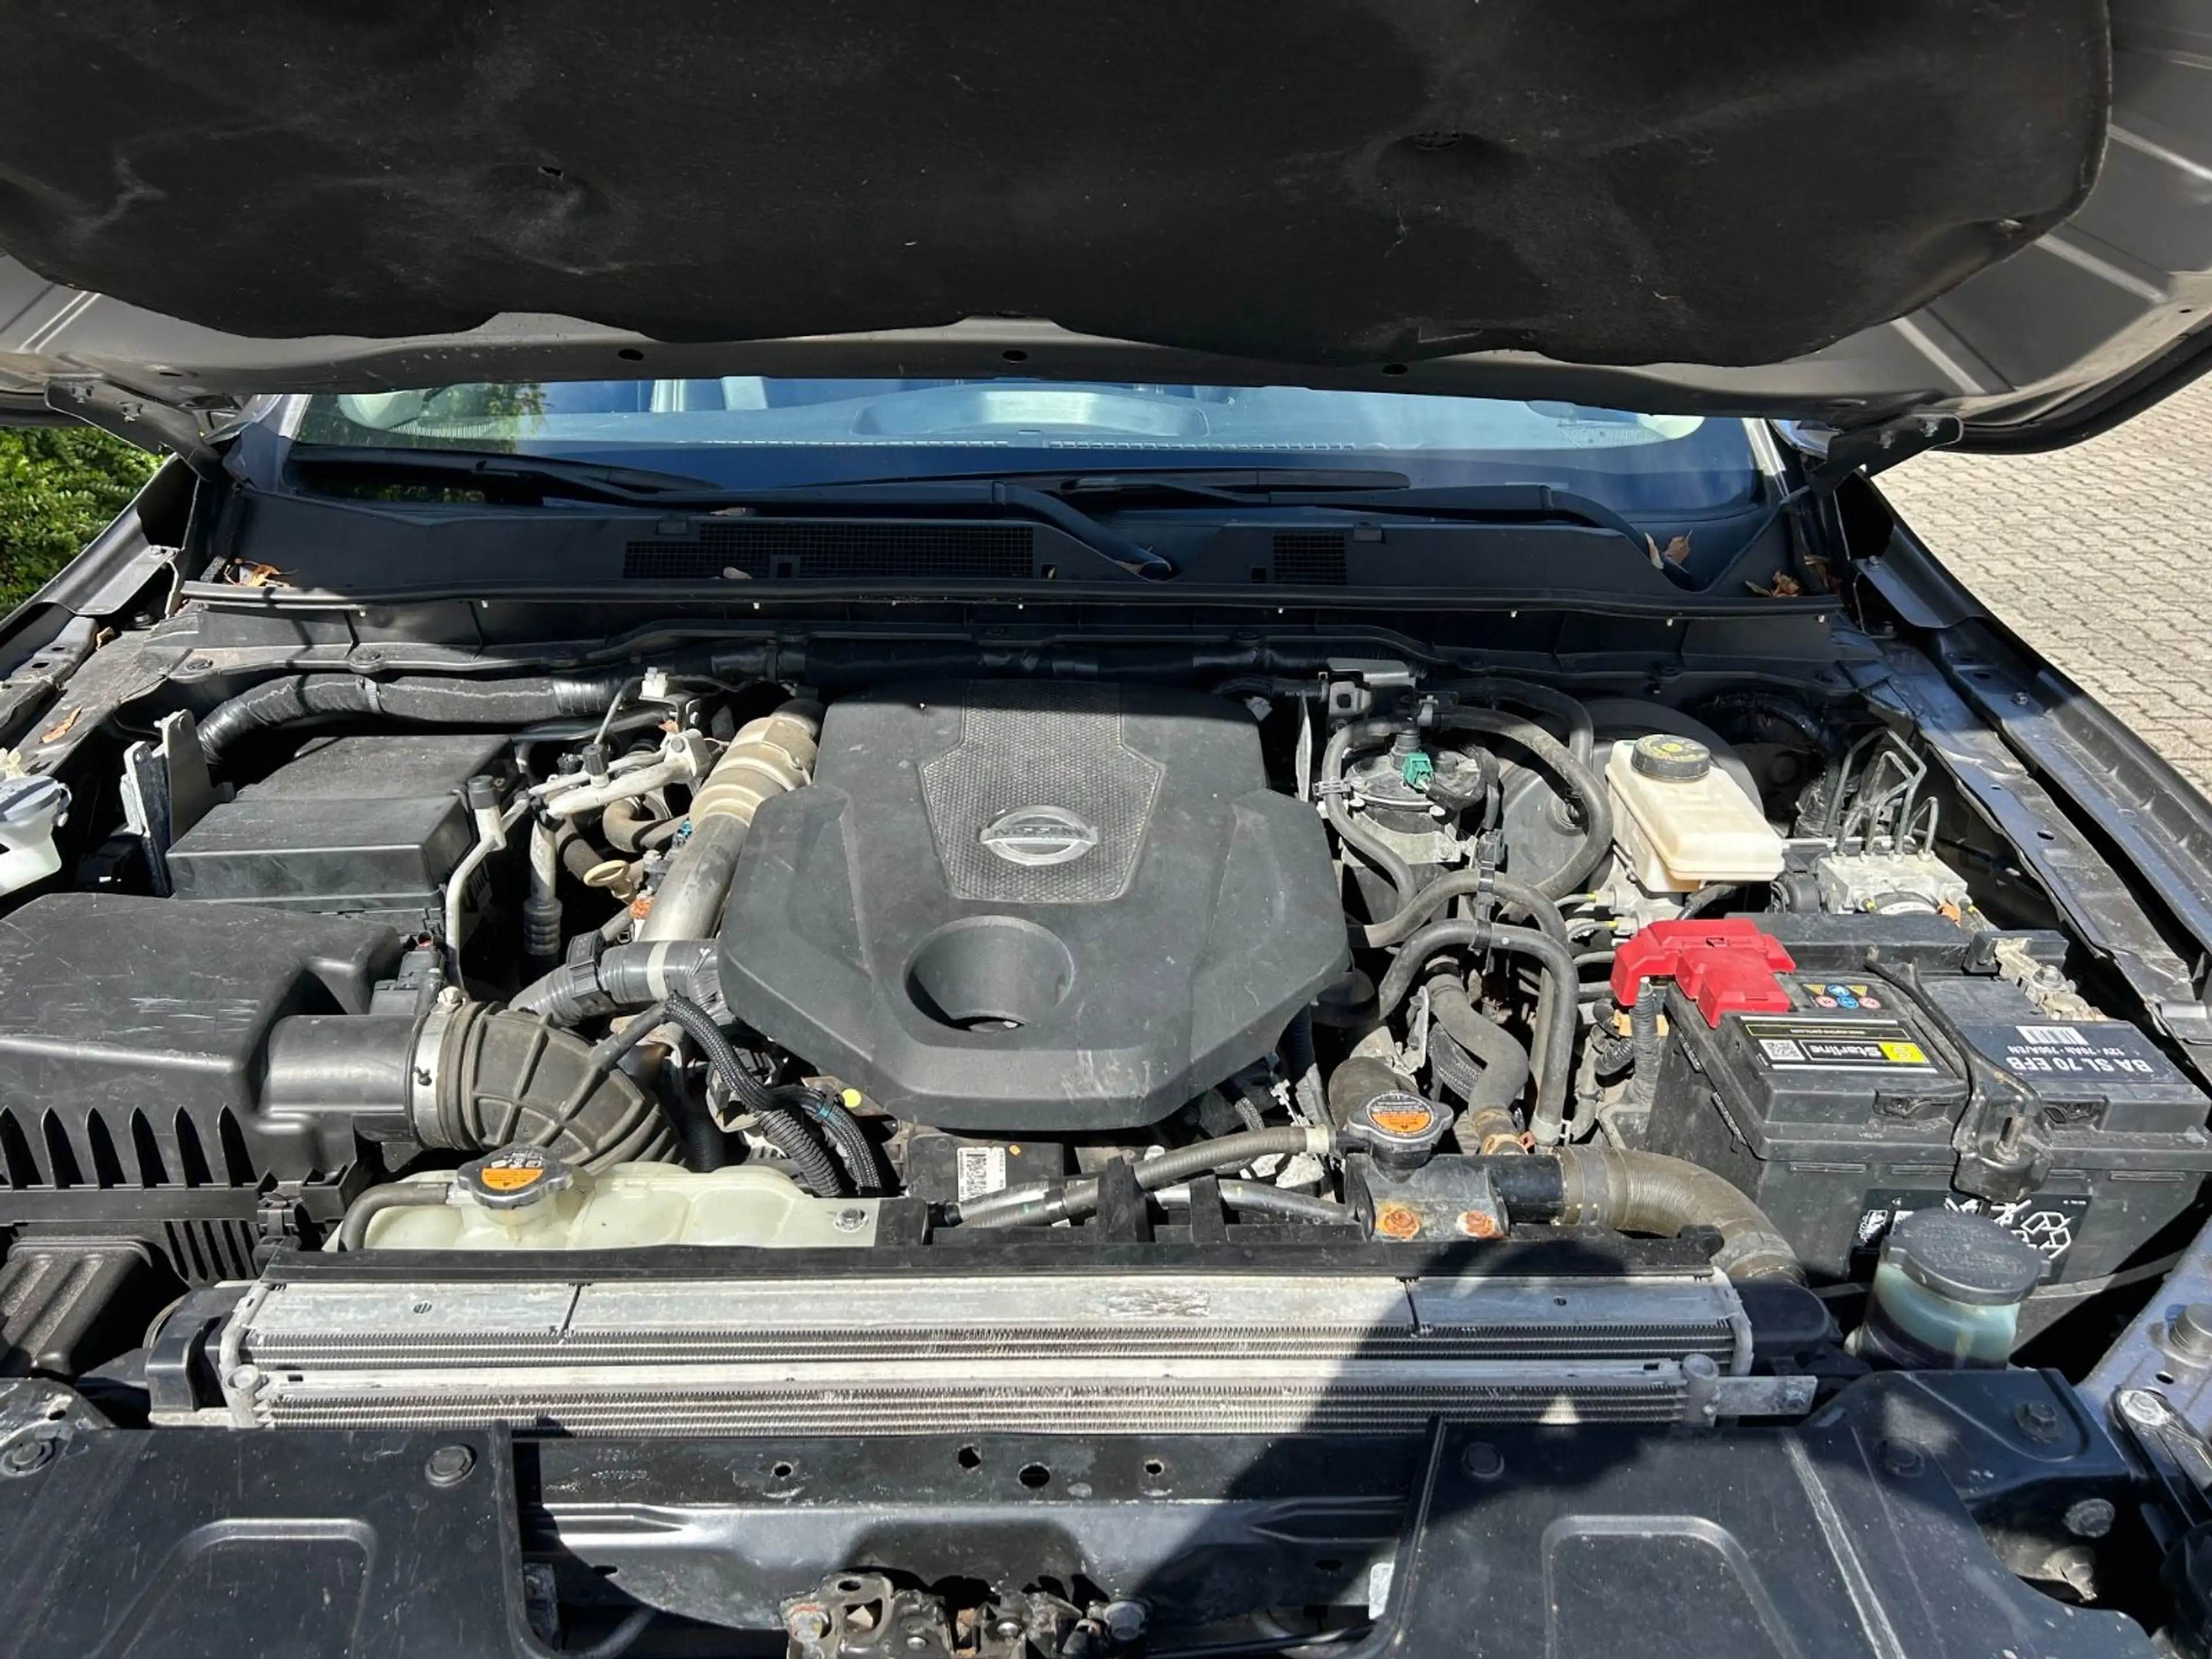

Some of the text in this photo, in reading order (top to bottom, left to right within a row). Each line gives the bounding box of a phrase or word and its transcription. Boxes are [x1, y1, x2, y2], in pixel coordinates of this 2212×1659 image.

[1810, 1044, 1883, 1058] Starline
[2006, 1056, 2154, 1073] BA SL 70 EFB
